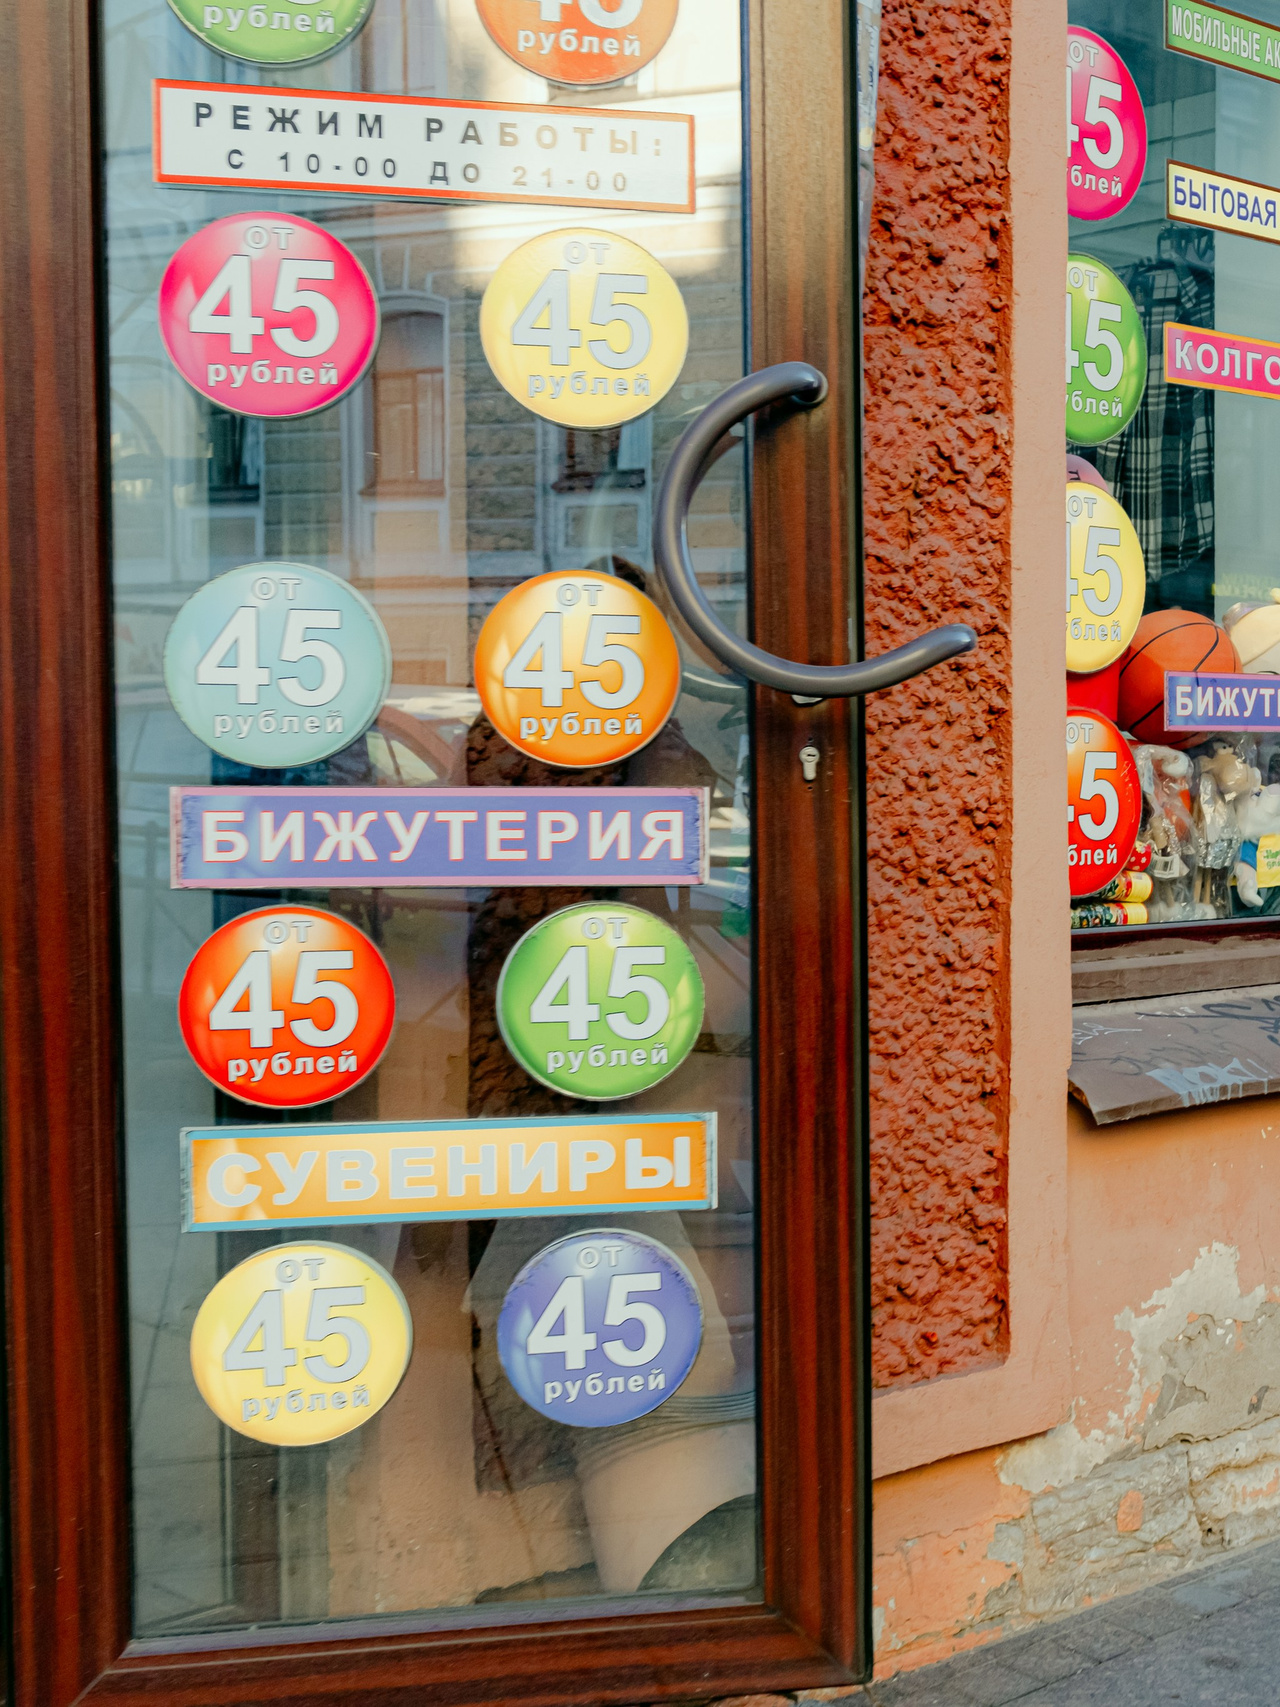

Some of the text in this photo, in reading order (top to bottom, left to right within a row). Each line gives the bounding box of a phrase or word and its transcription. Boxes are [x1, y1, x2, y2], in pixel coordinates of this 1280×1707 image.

[203, 4, 335, 34] рублей
[1171, 7, 1261, 63] МОБИЛЬНЫЕ
[517, 28, 641, 57] рублей
[194, 102, 661, 157] РЕЖИМ РАБОТЫ:
[227, 149, 627, 192] С 10-00 ДО 21-00
[1067, 165, 1122, 198] блей
[1173, 174, 1276, 229] БЫТОВАЯ
[188, 254, 341, 358] 45
[510, 268, 651, 370] 45
[206, 359, 339, 388] рублей
[527, 372, 650, 398] рублей
[1066, 390, 1123, 418] блей
[1066, 618, 1121, 641] блей
[196, 605, 346, 707] 45
[503, 612, 645, 709] 45
[213, 709, 344, 738] рублей
[520, 713, 643, 740] рублей
[1068, 751, 1119, 841] 5
[202, 810, 685, 863] БИЖУТЕРИЯ
[1068, 844, 1118, 866] блей
[208, 949, 359, 1048] 45
[529, 945, 670, 1041] 45
[227, 1049, 357, 1081] рублей
[546, 1043, 669, 1073] рублей
[207, 1136, 691, 1208] СУВЕНИРЫ
[223, 1286, 372, 1387] 45
[526, 1271, 667, 1370] 45
[241, 1384, 372, 1422] рублей
[544, 1368, 667, 1403] рублей
